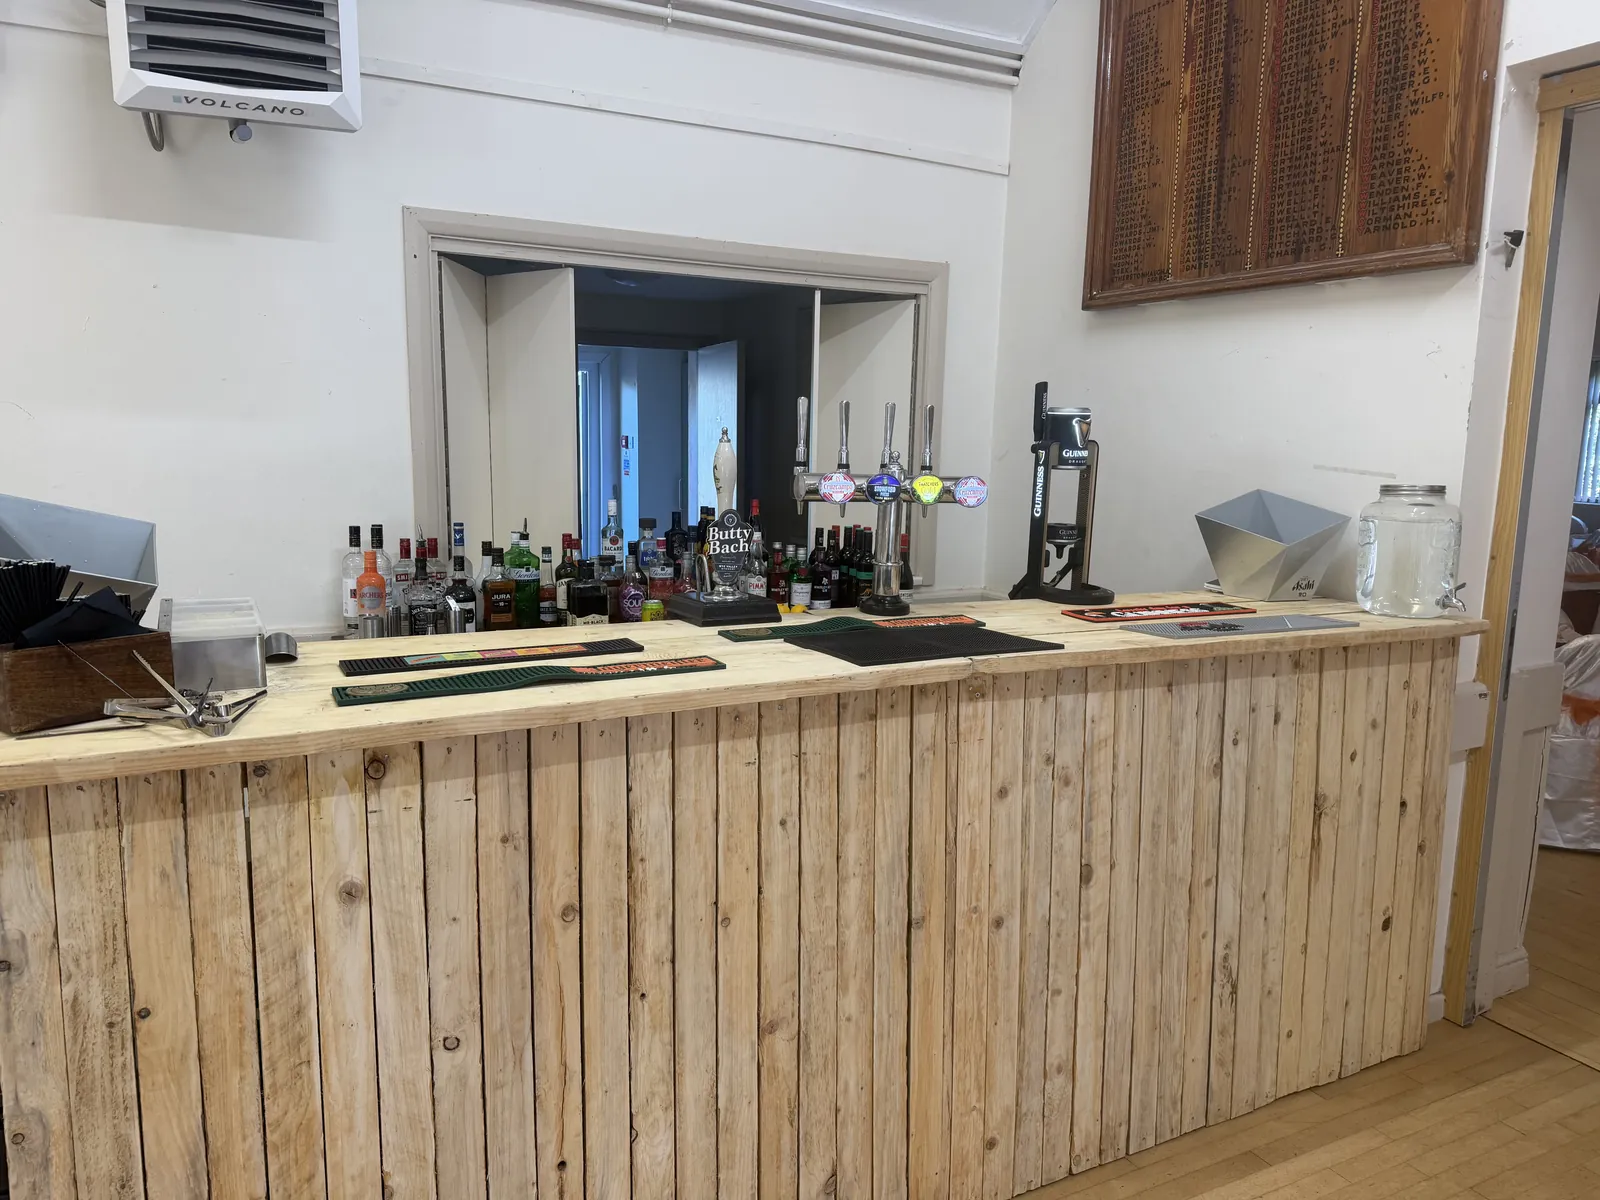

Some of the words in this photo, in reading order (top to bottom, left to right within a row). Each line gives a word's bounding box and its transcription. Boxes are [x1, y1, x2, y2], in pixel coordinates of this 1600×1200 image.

[184, 96, 305, 116] VOLCANO
[1033, 465, 1046, 518] GUINNESS
[708, 526, 752, 541] Butty
[708, 538, 750, 556] Bach
[491, 593, 512, 601] JURA
